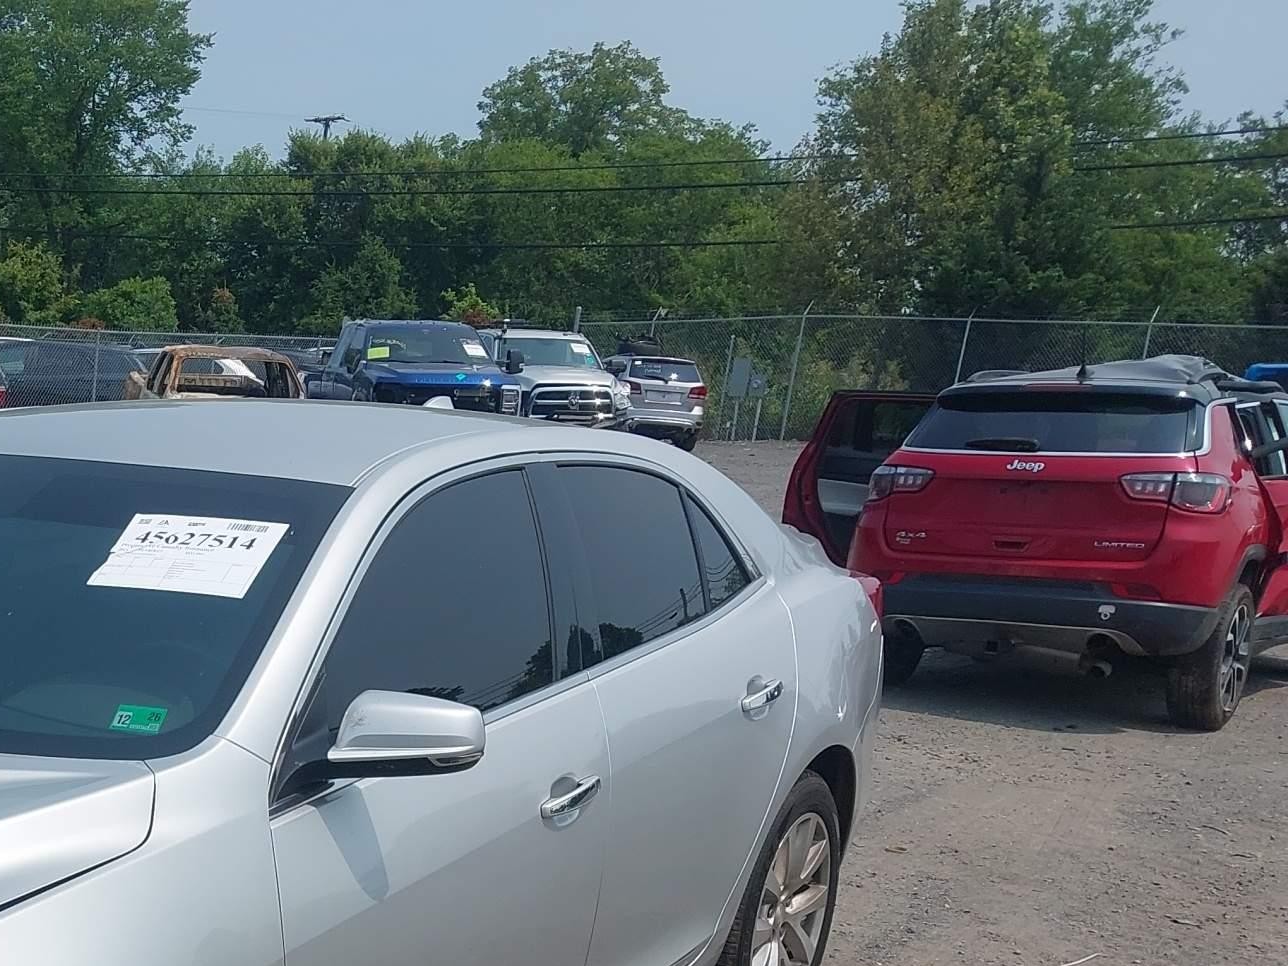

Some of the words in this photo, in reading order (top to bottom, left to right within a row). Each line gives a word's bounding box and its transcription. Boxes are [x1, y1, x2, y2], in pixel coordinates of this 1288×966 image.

[1006, 459, 1045, 473] Jeep
[135, 529, 258, 551] 45627514
[1094, 541, 1146, 549] LIMITED
[116, 713, 132, 725] 12
